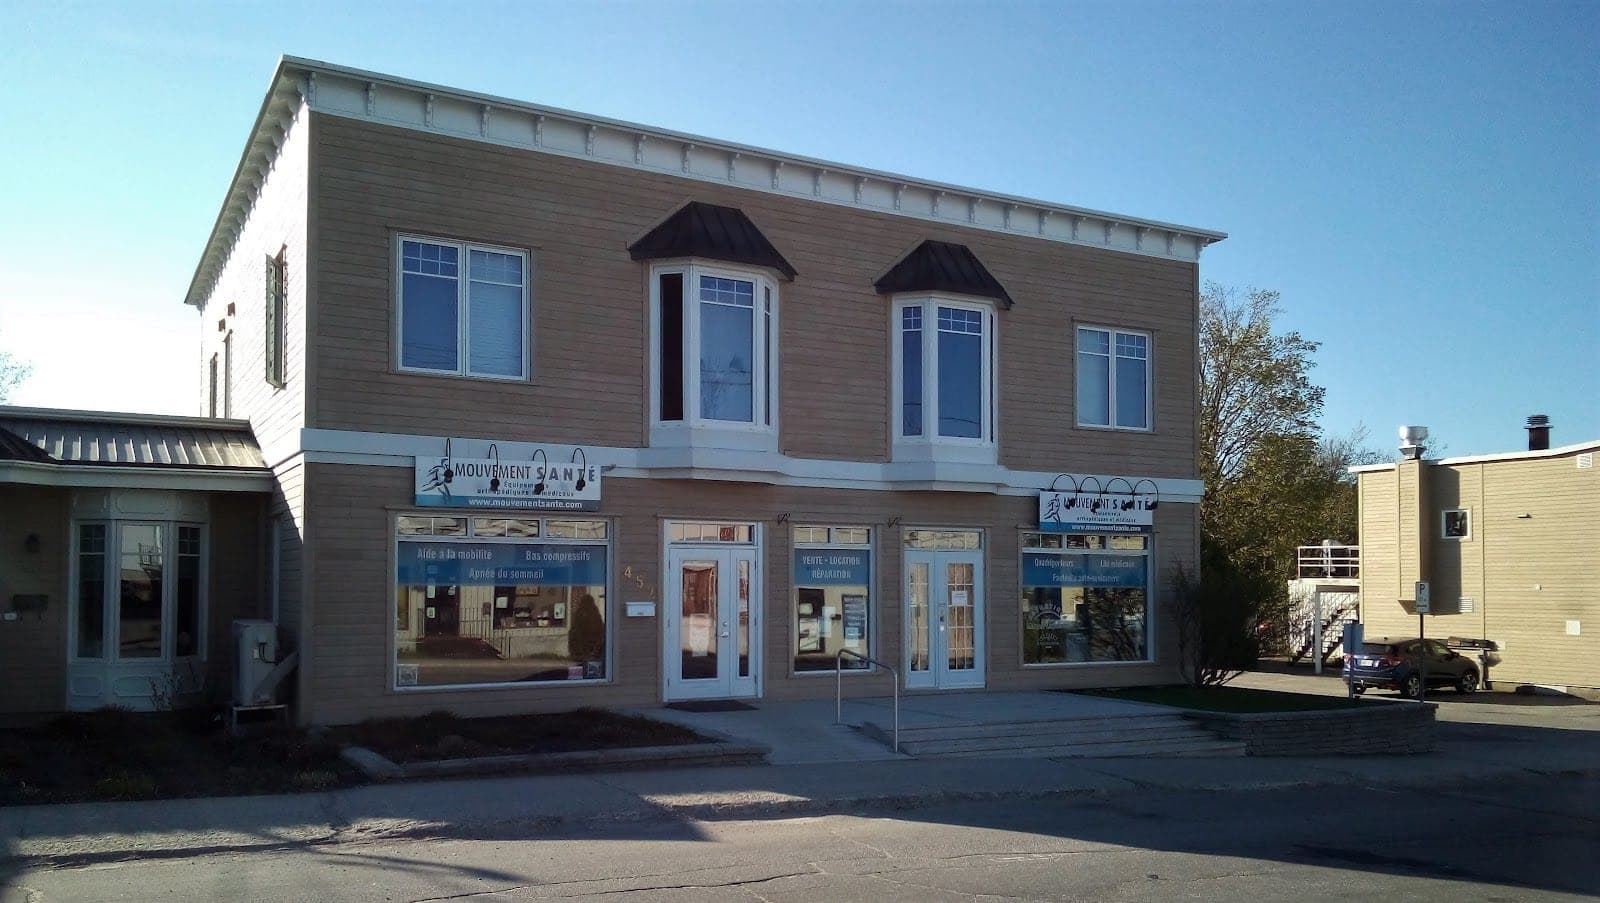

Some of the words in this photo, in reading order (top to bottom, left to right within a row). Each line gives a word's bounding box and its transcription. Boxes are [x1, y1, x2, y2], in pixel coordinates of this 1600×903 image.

[455, 463, 531, 479] MOUVEMENT
[536, 466, 596, 482] SANTÉ
[468, 498, 583, 509] www.mouvementsante.com
[417, 548, 437, 559] Aide
[446, 548, 456, 559] la
[526, 550, 541, 561] Bas
[543, 550, 591, 563] compressifs
[802, 555, 823, 565] VENTE
[829, 556, 861, 566] LOCATION
[469, 567, 495, 580] Apnée
[497, 568, 508, 579] du
[511, 568, 544, 580] sommeil
[812, 568, 851, 579] RÉPARATION
[1419, 583, 1426, 595] P
